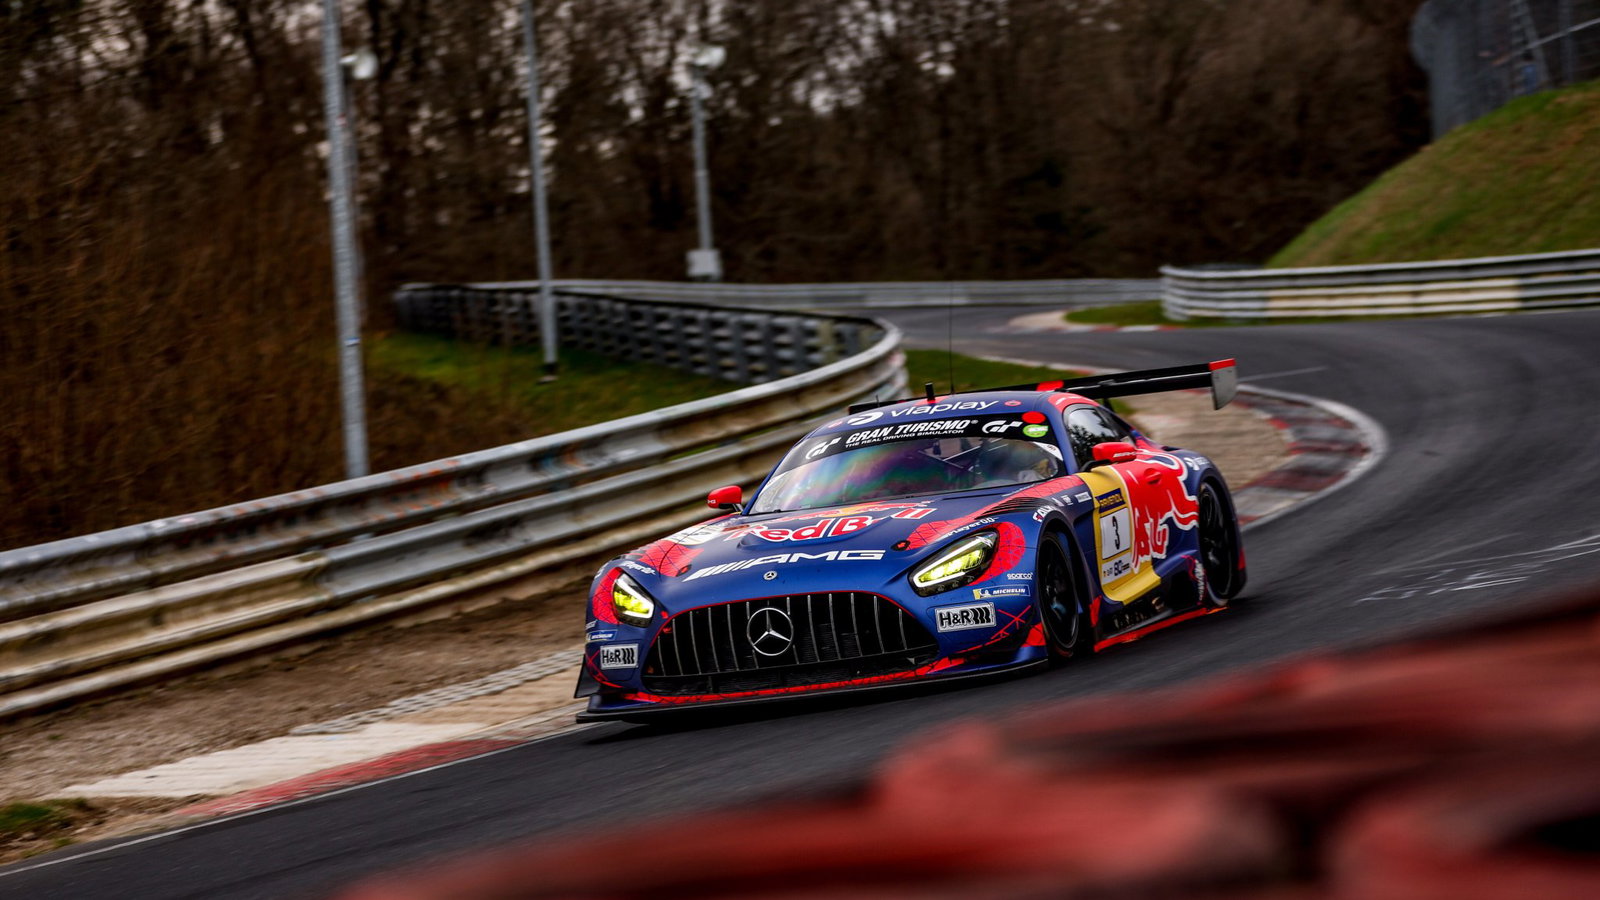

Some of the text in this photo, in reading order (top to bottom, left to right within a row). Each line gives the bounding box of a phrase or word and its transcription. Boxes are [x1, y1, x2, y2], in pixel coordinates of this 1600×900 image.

[891, 400, 999, 418] viaplay
[845, 429, 965, 449] THE REAL DRIVING SIMULATOR
[846, 426, 895, 445] GRAN
[724, 517, 833, 543] Red
[827, 508, 938, 532] Bll
[1112, 516, 1121, 550] 3
